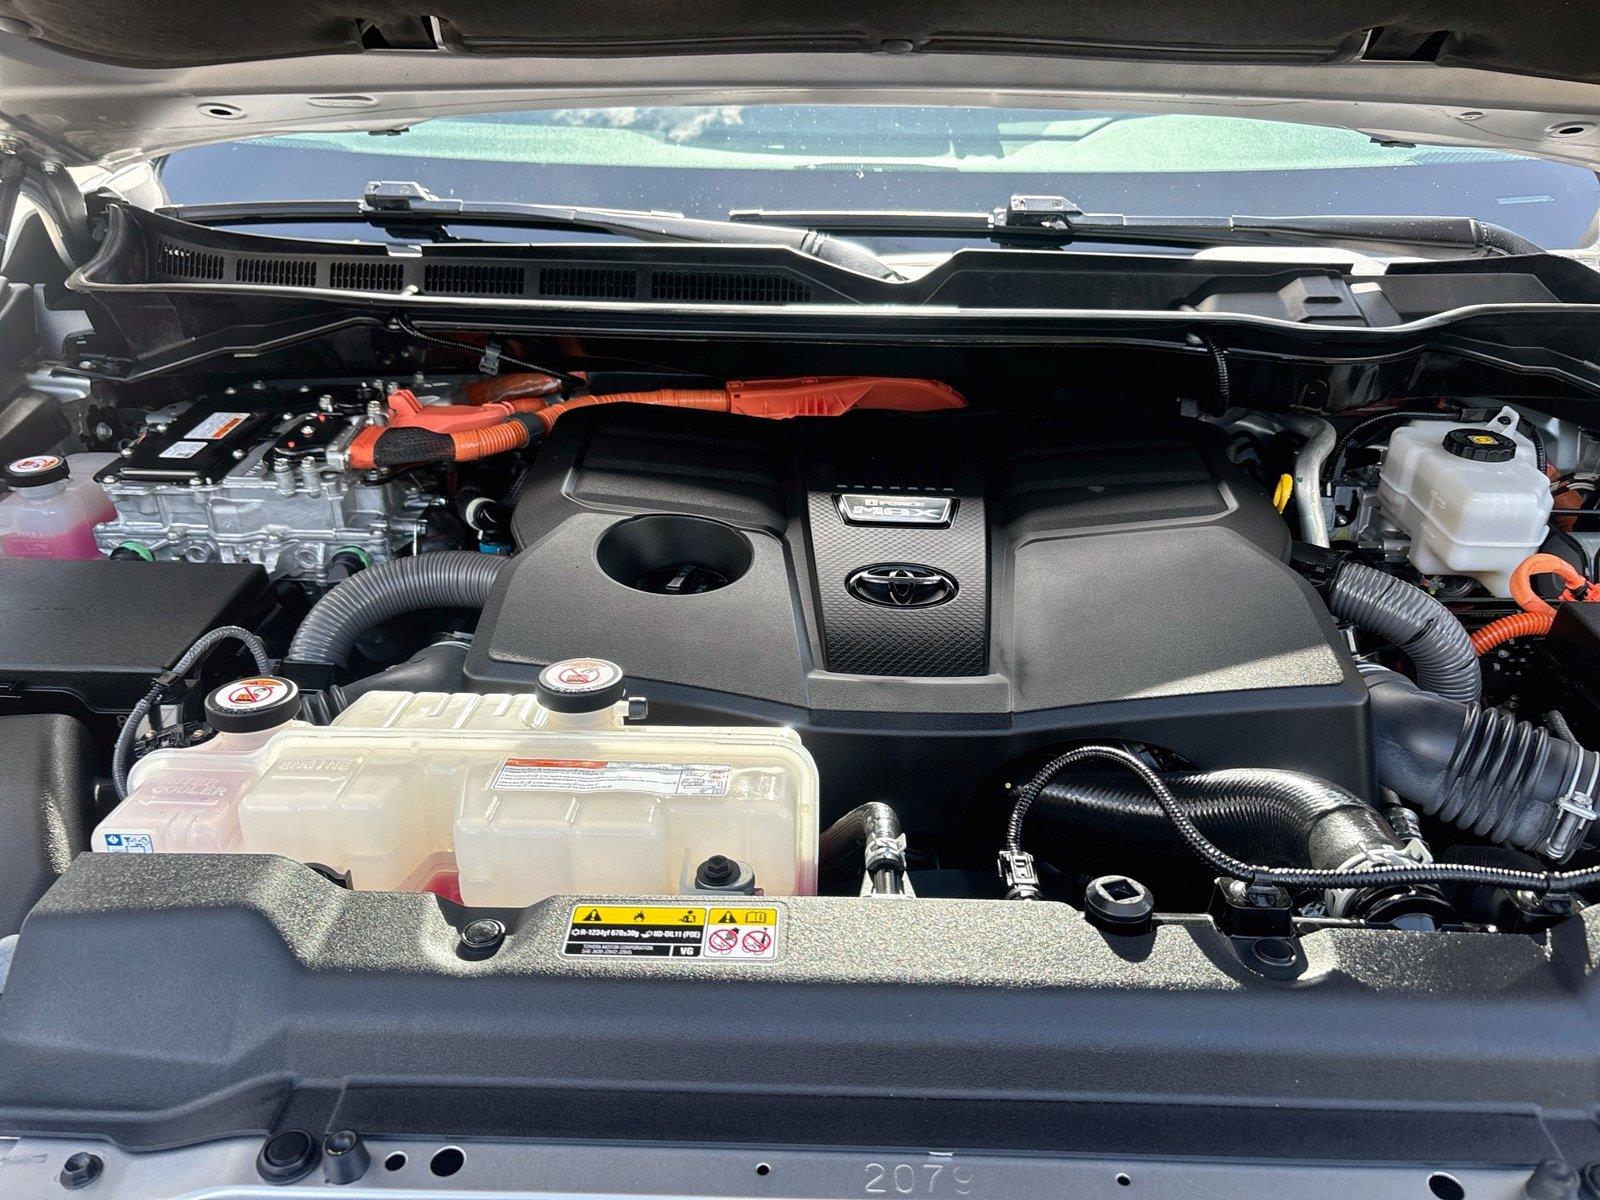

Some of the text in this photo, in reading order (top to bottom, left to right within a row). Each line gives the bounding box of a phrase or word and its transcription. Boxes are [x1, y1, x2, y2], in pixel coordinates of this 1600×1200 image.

[853, 506, 940, 518] MAX
[278, 760, 350, 770] ENGINE
[680, 947, 694, 956] VG
[864, 1163, 974, 1195] 2079
